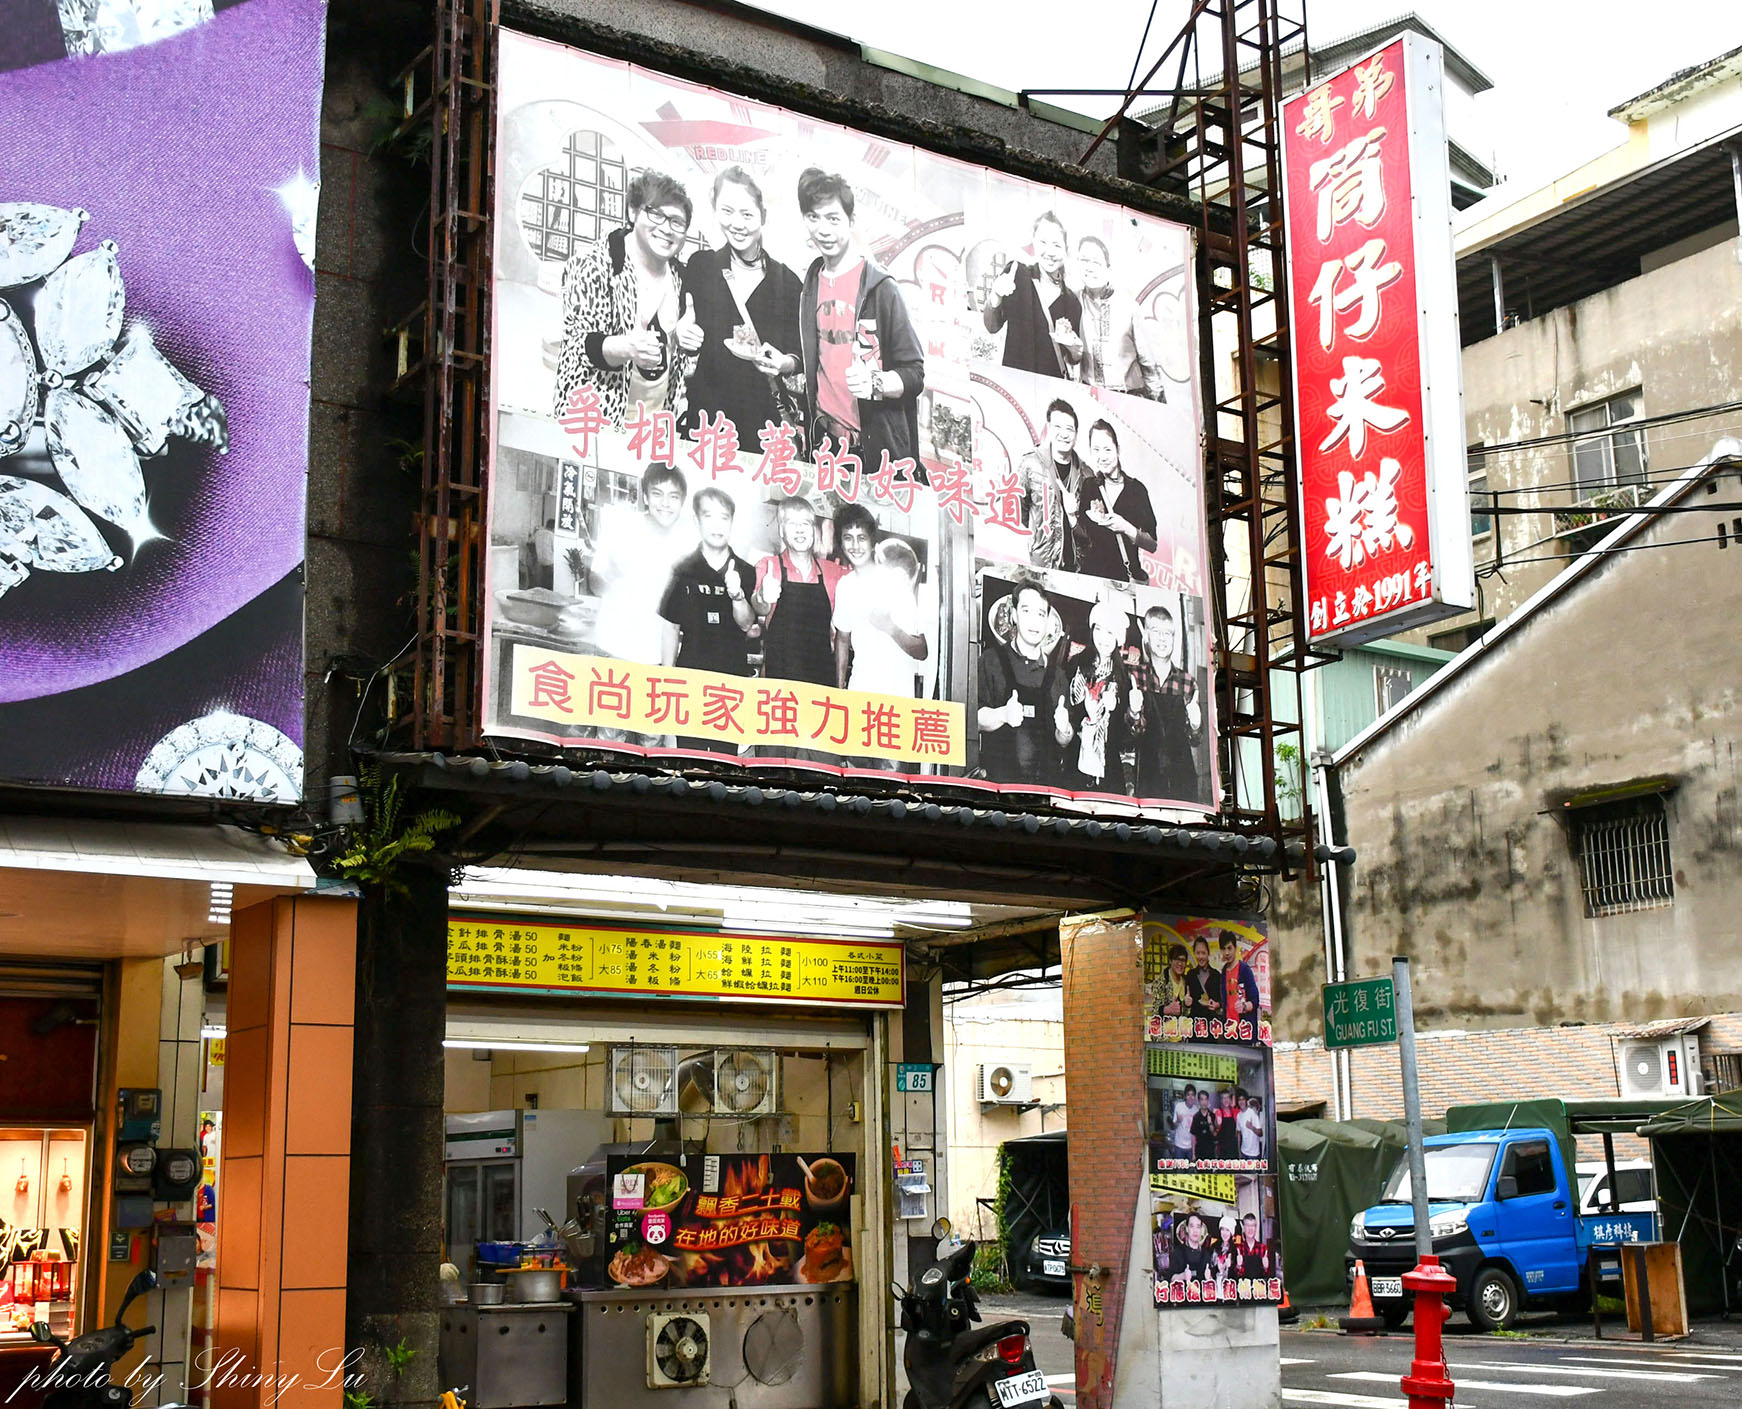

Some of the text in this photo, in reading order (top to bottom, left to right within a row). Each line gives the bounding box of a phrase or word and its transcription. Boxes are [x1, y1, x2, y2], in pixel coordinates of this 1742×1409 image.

[1308, 127, 1413, 572] 筒仔米糕
[528, 660, 951, 756] 食尚玩家強力推薦
[525, 931, 538, 942] 50
[525, 944, 538, 955] 50
[557, 943, 584, 953] 米粉
[599, 943, 623, 955] 小75
[525, 957, 538, 967] 50
[543, 953, 556, 963] 加
[557, 954, 584, 963] 冬粉
[525, 970, 538, 980] 50
[599, 964, 622, 975] 大85
[1334, 986, 1391, 1014] 光復街
[1335, 1018, 1396, 1041] GUANG FU ST.
[912, 1074, 926, 1088] 85
[676, 1219, 801, 1247] 在地的好味道
